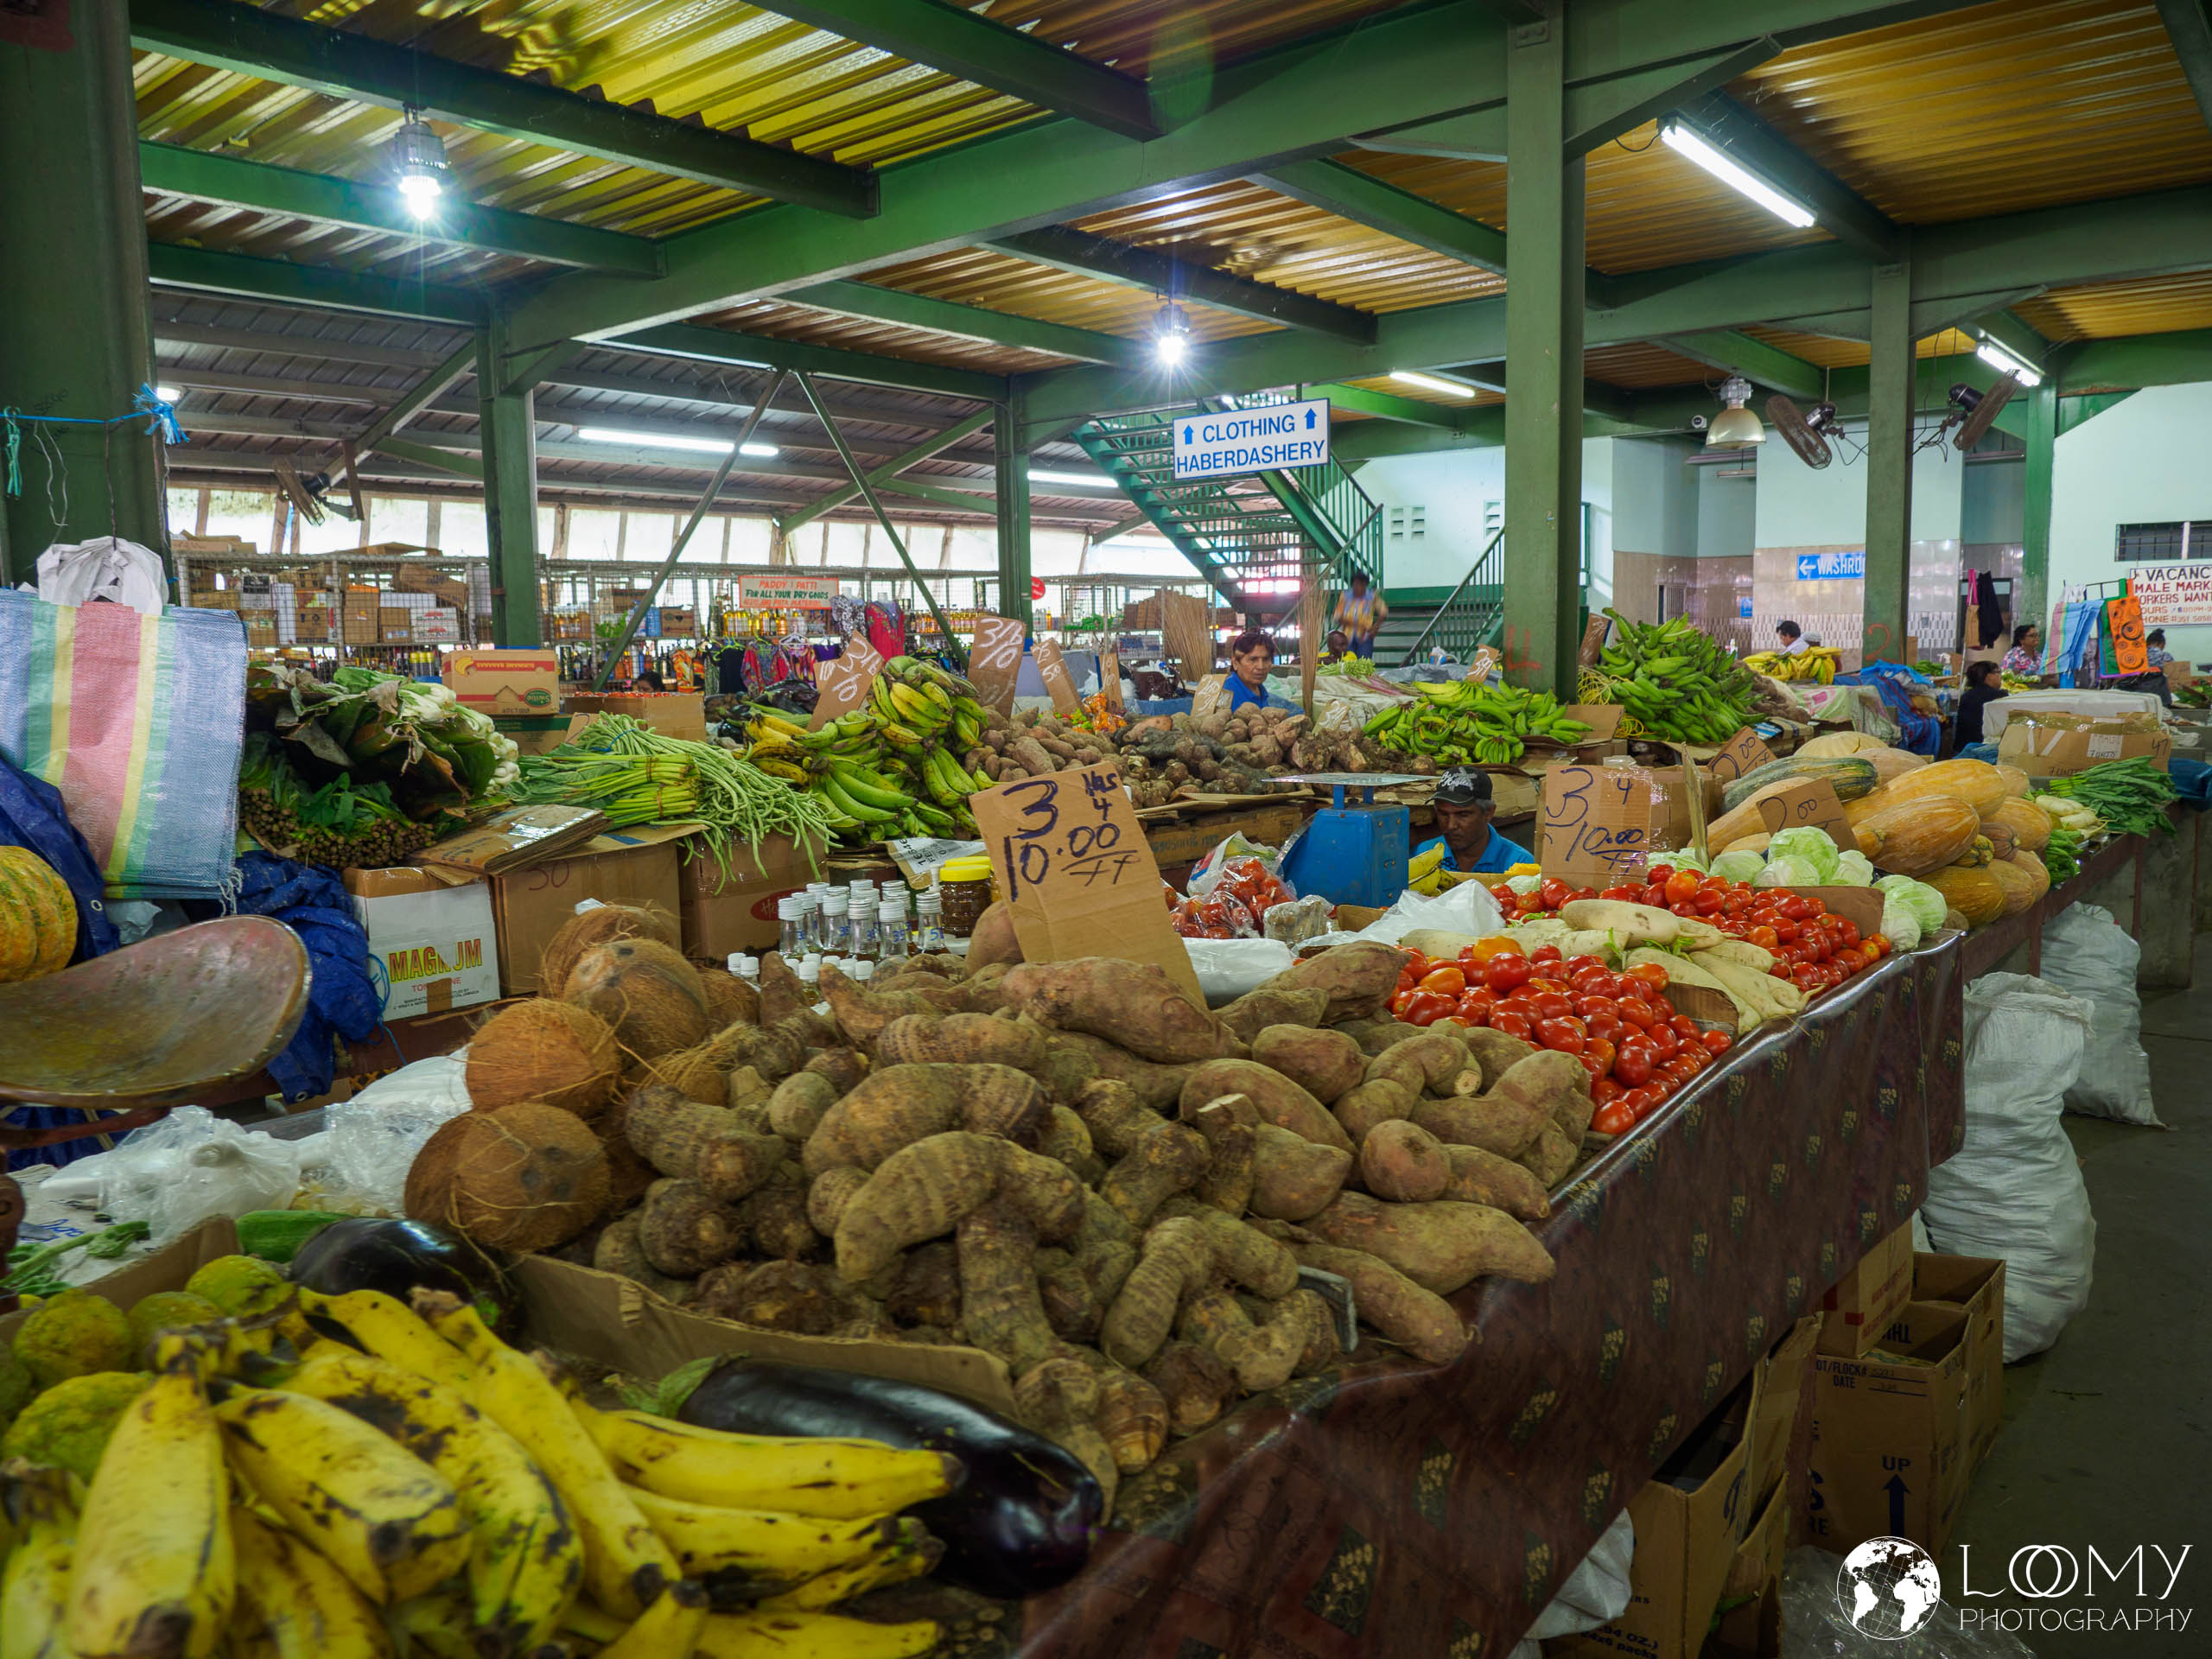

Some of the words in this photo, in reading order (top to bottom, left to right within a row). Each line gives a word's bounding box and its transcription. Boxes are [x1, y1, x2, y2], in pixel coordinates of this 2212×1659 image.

[1203, 415, 1295, 443] CLOTHING
[1177, 440, 1325, 474] HABERDASHERY
[2146, 566, 2212, 582] VACANC
[746, 588, 759, 597] FOR
[760, 589, 772, 598] ALL
[774, 589, 791, 599] YOUR
[793, 590, 807, 600] DRY
[808, 591, 829, 600] GOODS
[2135, 582, 2171, 594] MALE
[2177, 580, 2212, 592] MARK
[2139, 593, 2179, 605] ORKERS
[2141, 606, 2168, 615] OURS
[1865, 622, 1898, 664] 2
[1544, 767, 1594, 827] 3
[1617, 777, 1634, 805] 4
[1001, 779, 1058, 840] 3
[1092, 798, 1113, 822] 4
[1003, 823, 1121, 902] 10.00
[1833, 1375, 1855, 1389] DATE
[1882, 1454, 1912, 1472] UP
